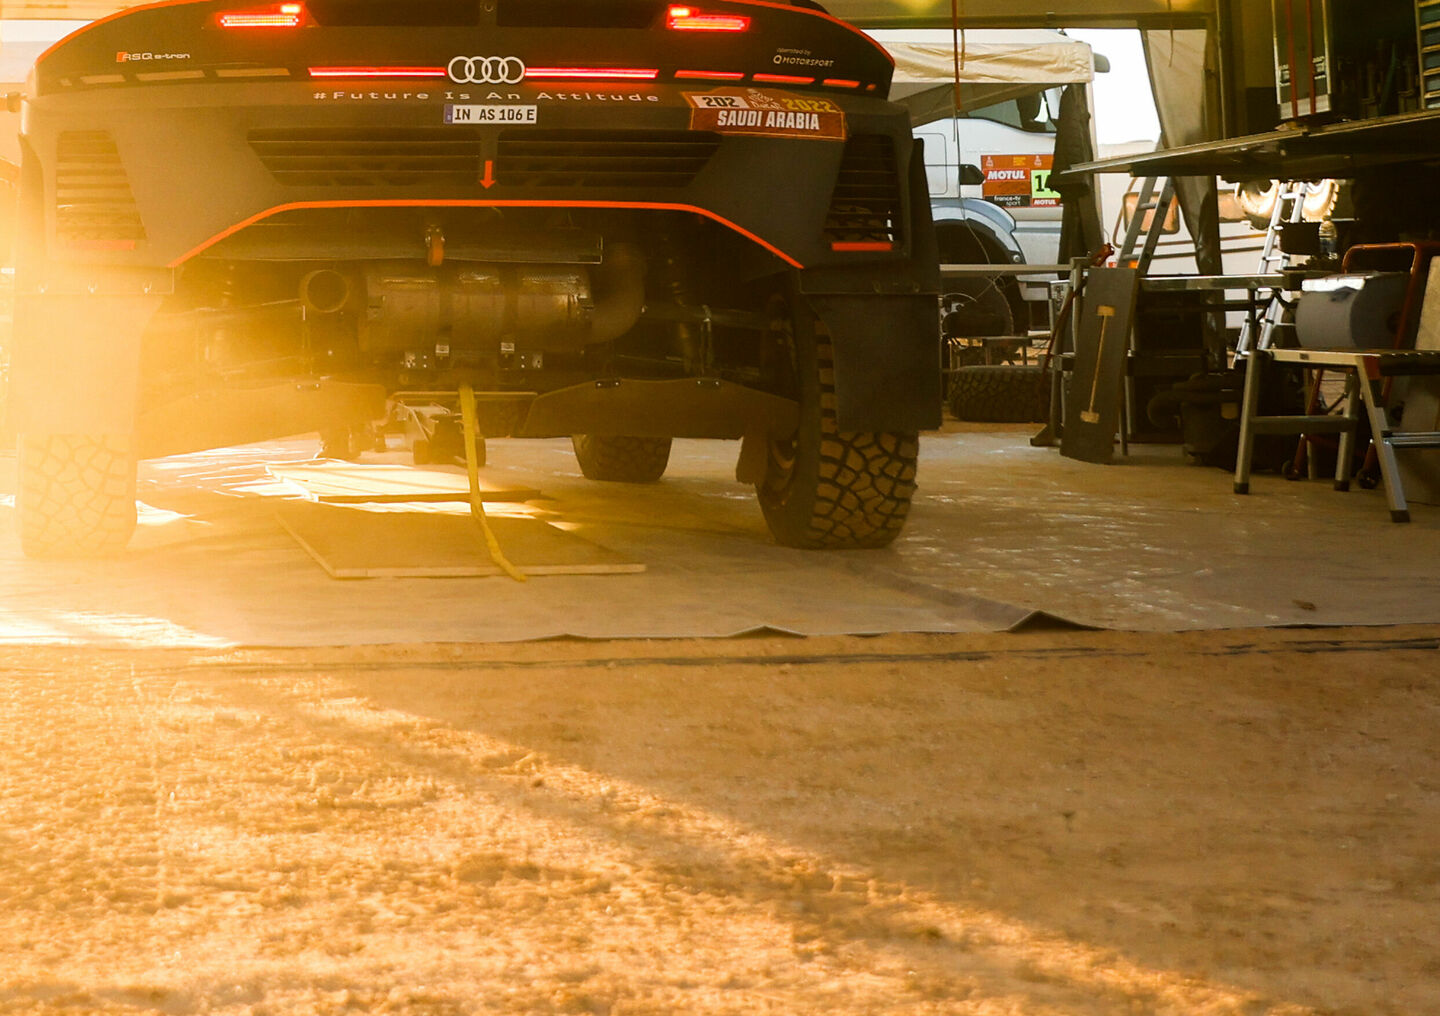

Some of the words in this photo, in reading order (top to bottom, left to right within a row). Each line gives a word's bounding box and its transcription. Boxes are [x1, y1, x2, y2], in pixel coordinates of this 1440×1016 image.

[313, 91, 429, 100] #Future
[444, 91, 471, 100] Is
[486, 91, 521, 100] An
[536, 91, 660, 102] Attitude
[702, 96, 740, 108] 202
[782, 97, 839, 113] 2022
[454, 108, 471, 121] IN
[478, 108, 496, 121] AS
[717, 110, 761, 127] SAUDI
[765, 111, 820, 130] ARABIA
[987, 170, 1026, 180] MOTUL
